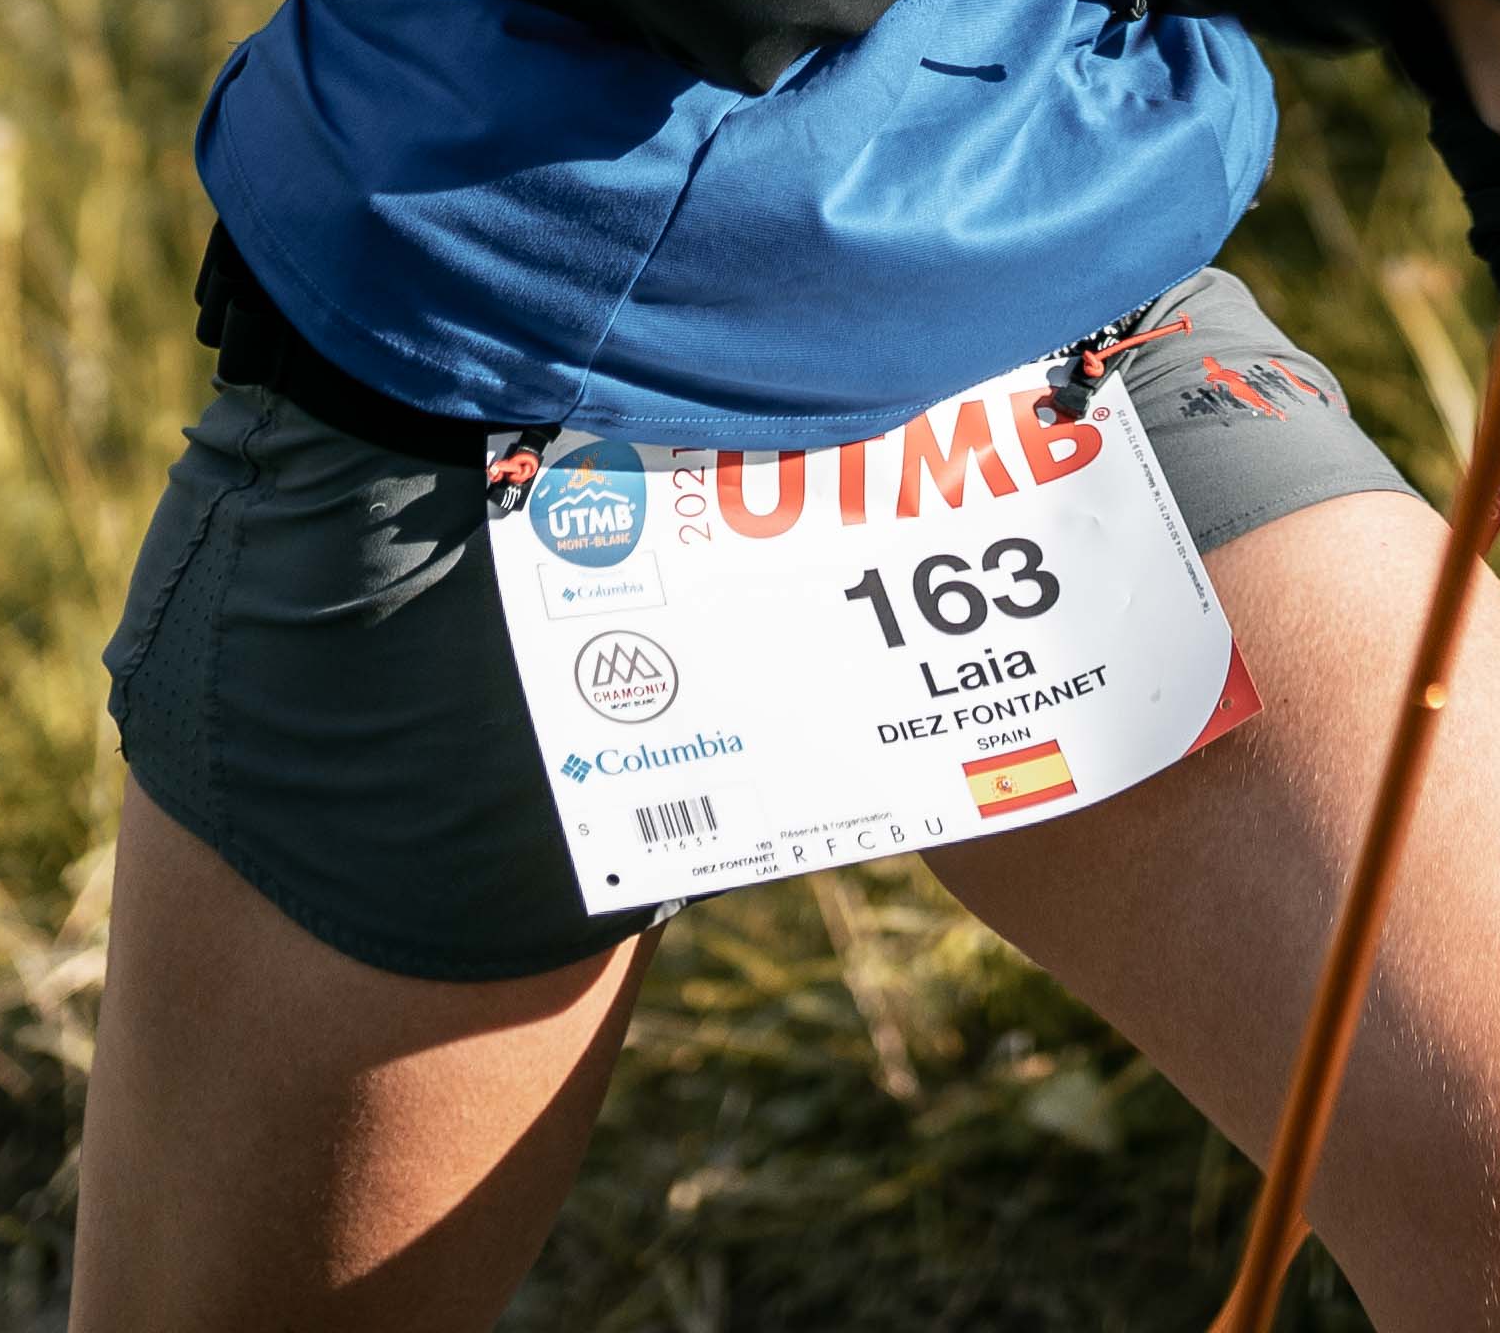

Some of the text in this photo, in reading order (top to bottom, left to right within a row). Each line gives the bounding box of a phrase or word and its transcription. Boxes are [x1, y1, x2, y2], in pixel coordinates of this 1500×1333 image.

[717, 387, 1102, 538] UTMB
[673, 448, 711, 544] 2021
[548, 504, 633, 538] UTMB
[557, 533, 630, 551] MONT-BLANC
[578, 581, 643, 598] Columbia
[844, 537, 1060, 648] 163
[920, 648, 1037, 698] Laia
[594, 682, 668, 702] CHAMONIX
[877, 665, 1108, 744] DIEZ FONTANET
[595, 730, 743, 775] Columbia
[976, 727, 1031, 750] SPAIN
[578, 823, 590, 836] S
[792, 816, 943, 863] R F C B U
[692, 852, 775, 876] DIEZ FONTANET
[756, 864, 780, 876] LAIA
